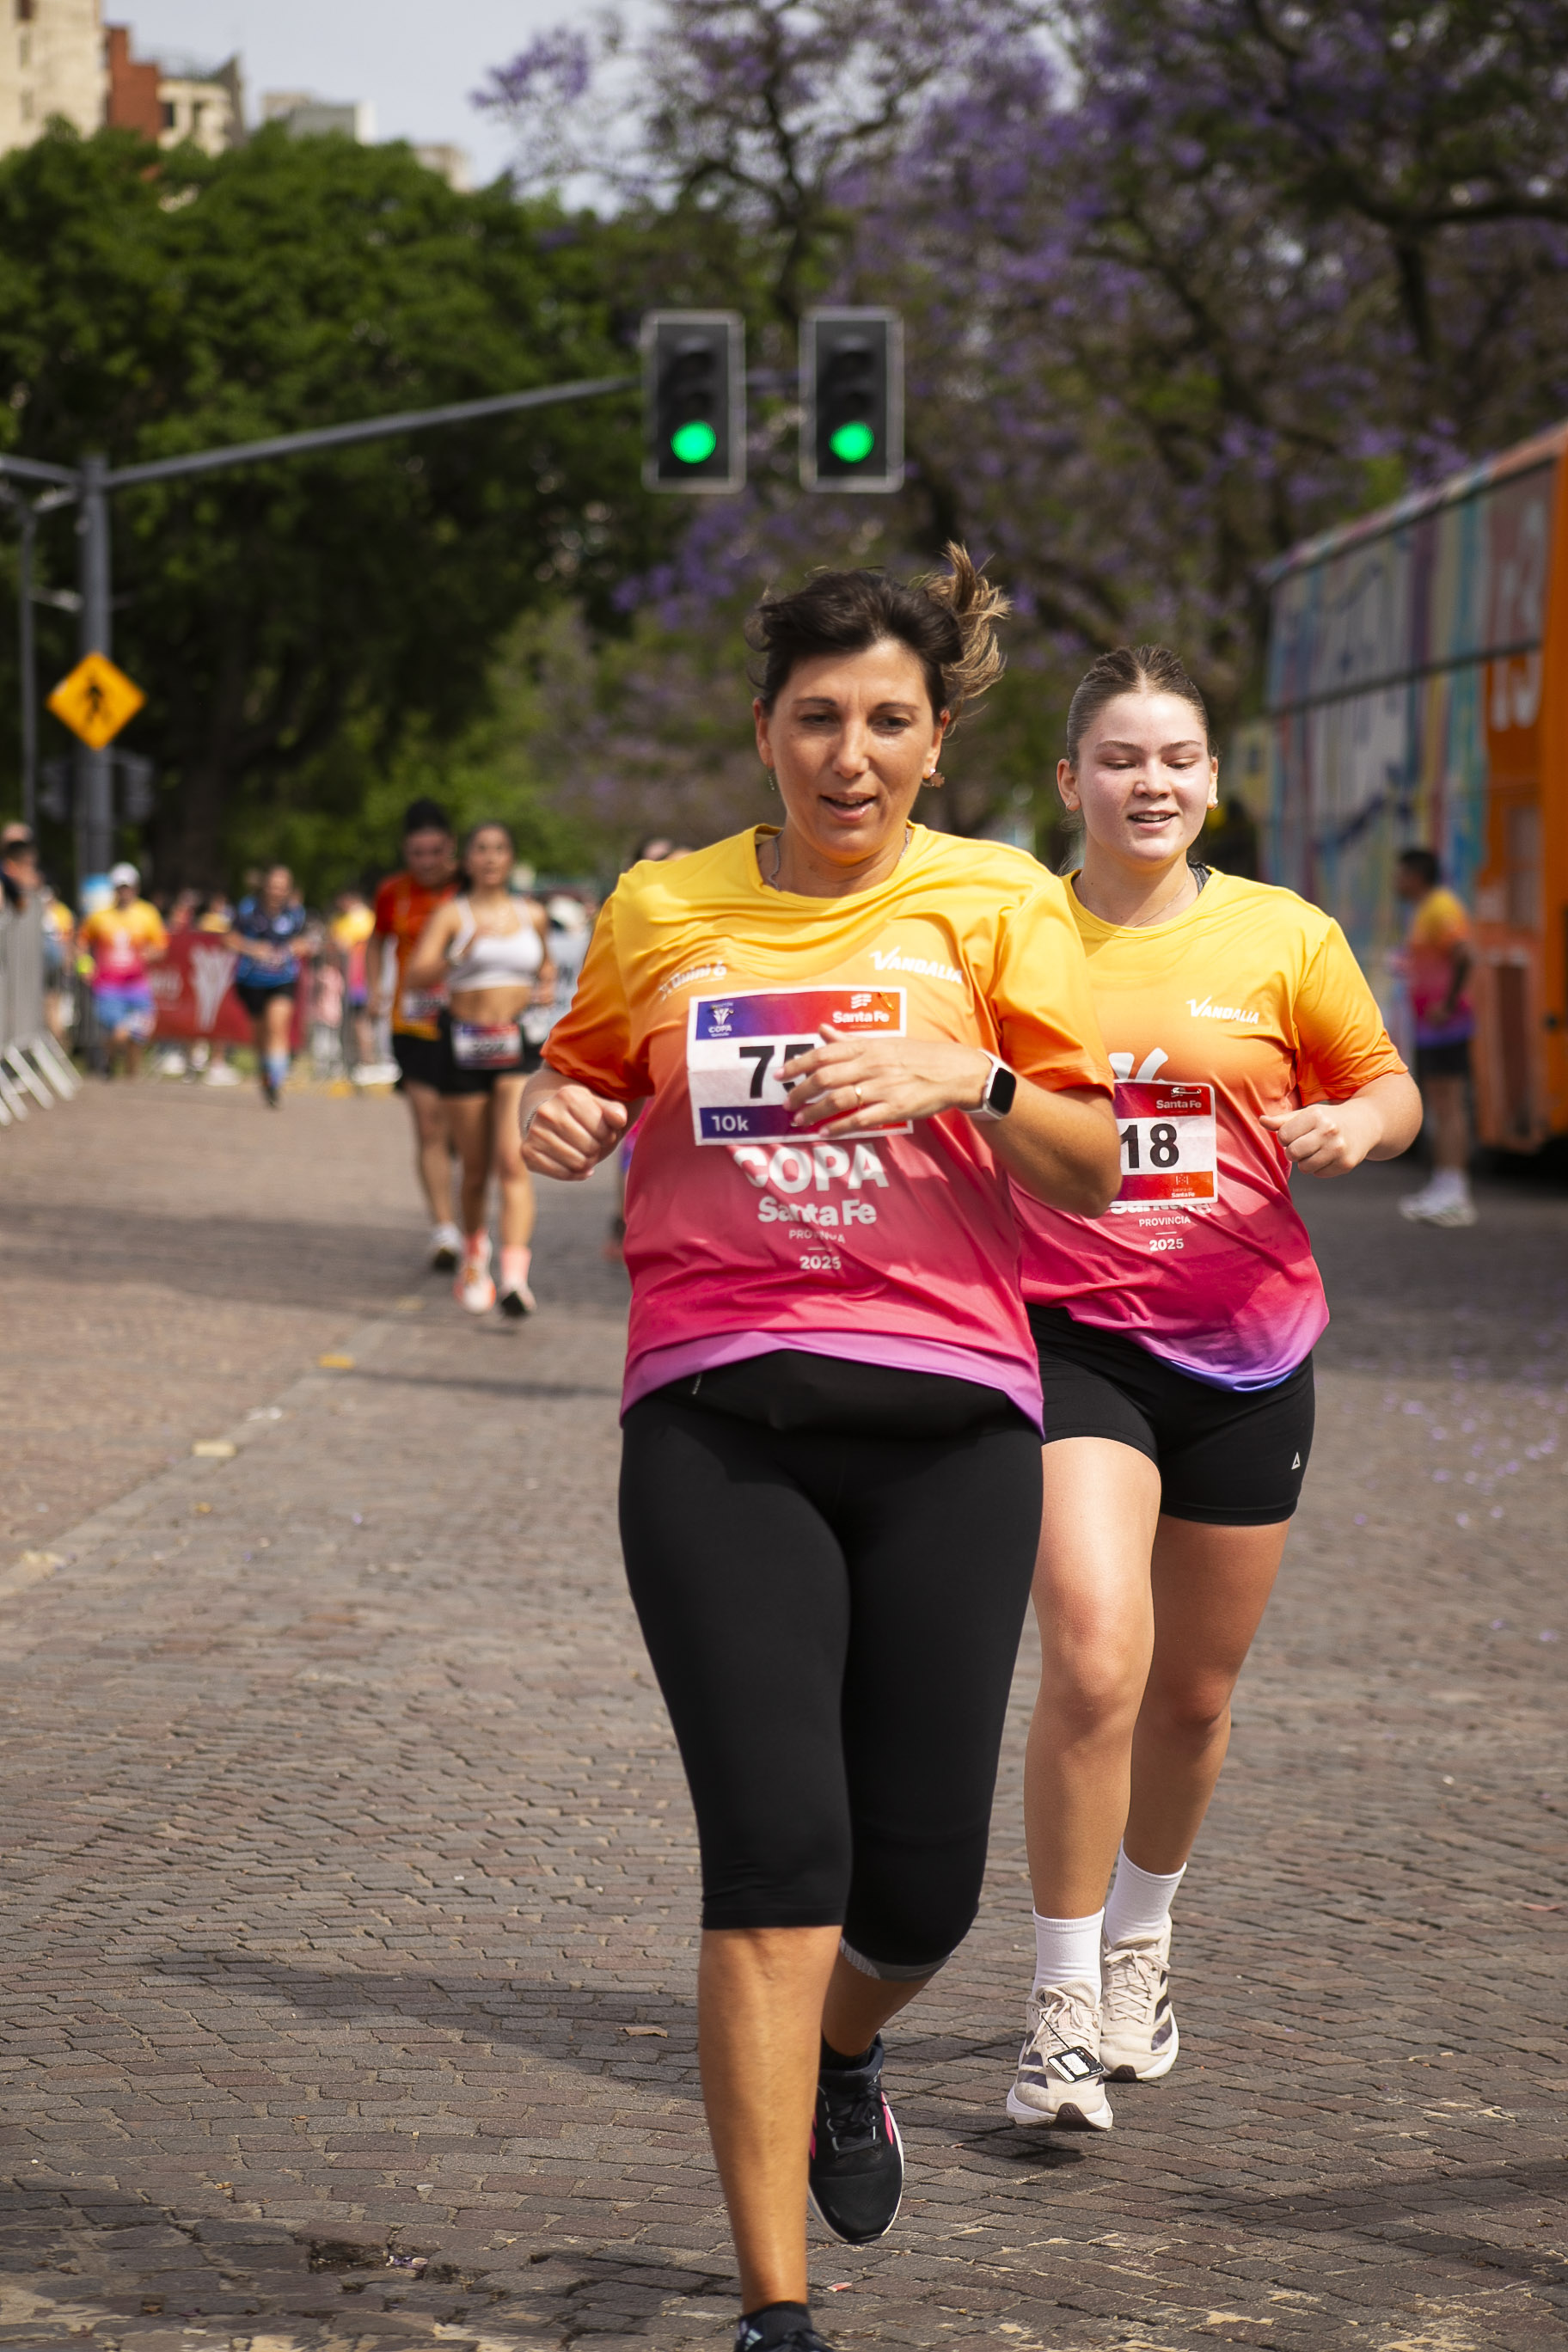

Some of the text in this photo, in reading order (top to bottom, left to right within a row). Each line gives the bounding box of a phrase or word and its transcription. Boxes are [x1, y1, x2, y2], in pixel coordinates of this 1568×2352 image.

[868, 946, 962, 984] VANDALIA
[832, 1010, 890, 1024] Santa Fe
[1185, 995, 1259, 1025] VANDALIA
[1155, 1099, 1203, 1110] Santa Fe
[711, 1115, 750, 1132] 10k
[734, 1142, 891, 1194] COPA
[757, 1195, 877, 1228] Santa Fe
[1138, 1215, 1191, 1228] PROVINCIA
[1148, 1238, 1185, 1253] 2025
[799, 1255, 842, 1271] 2025
